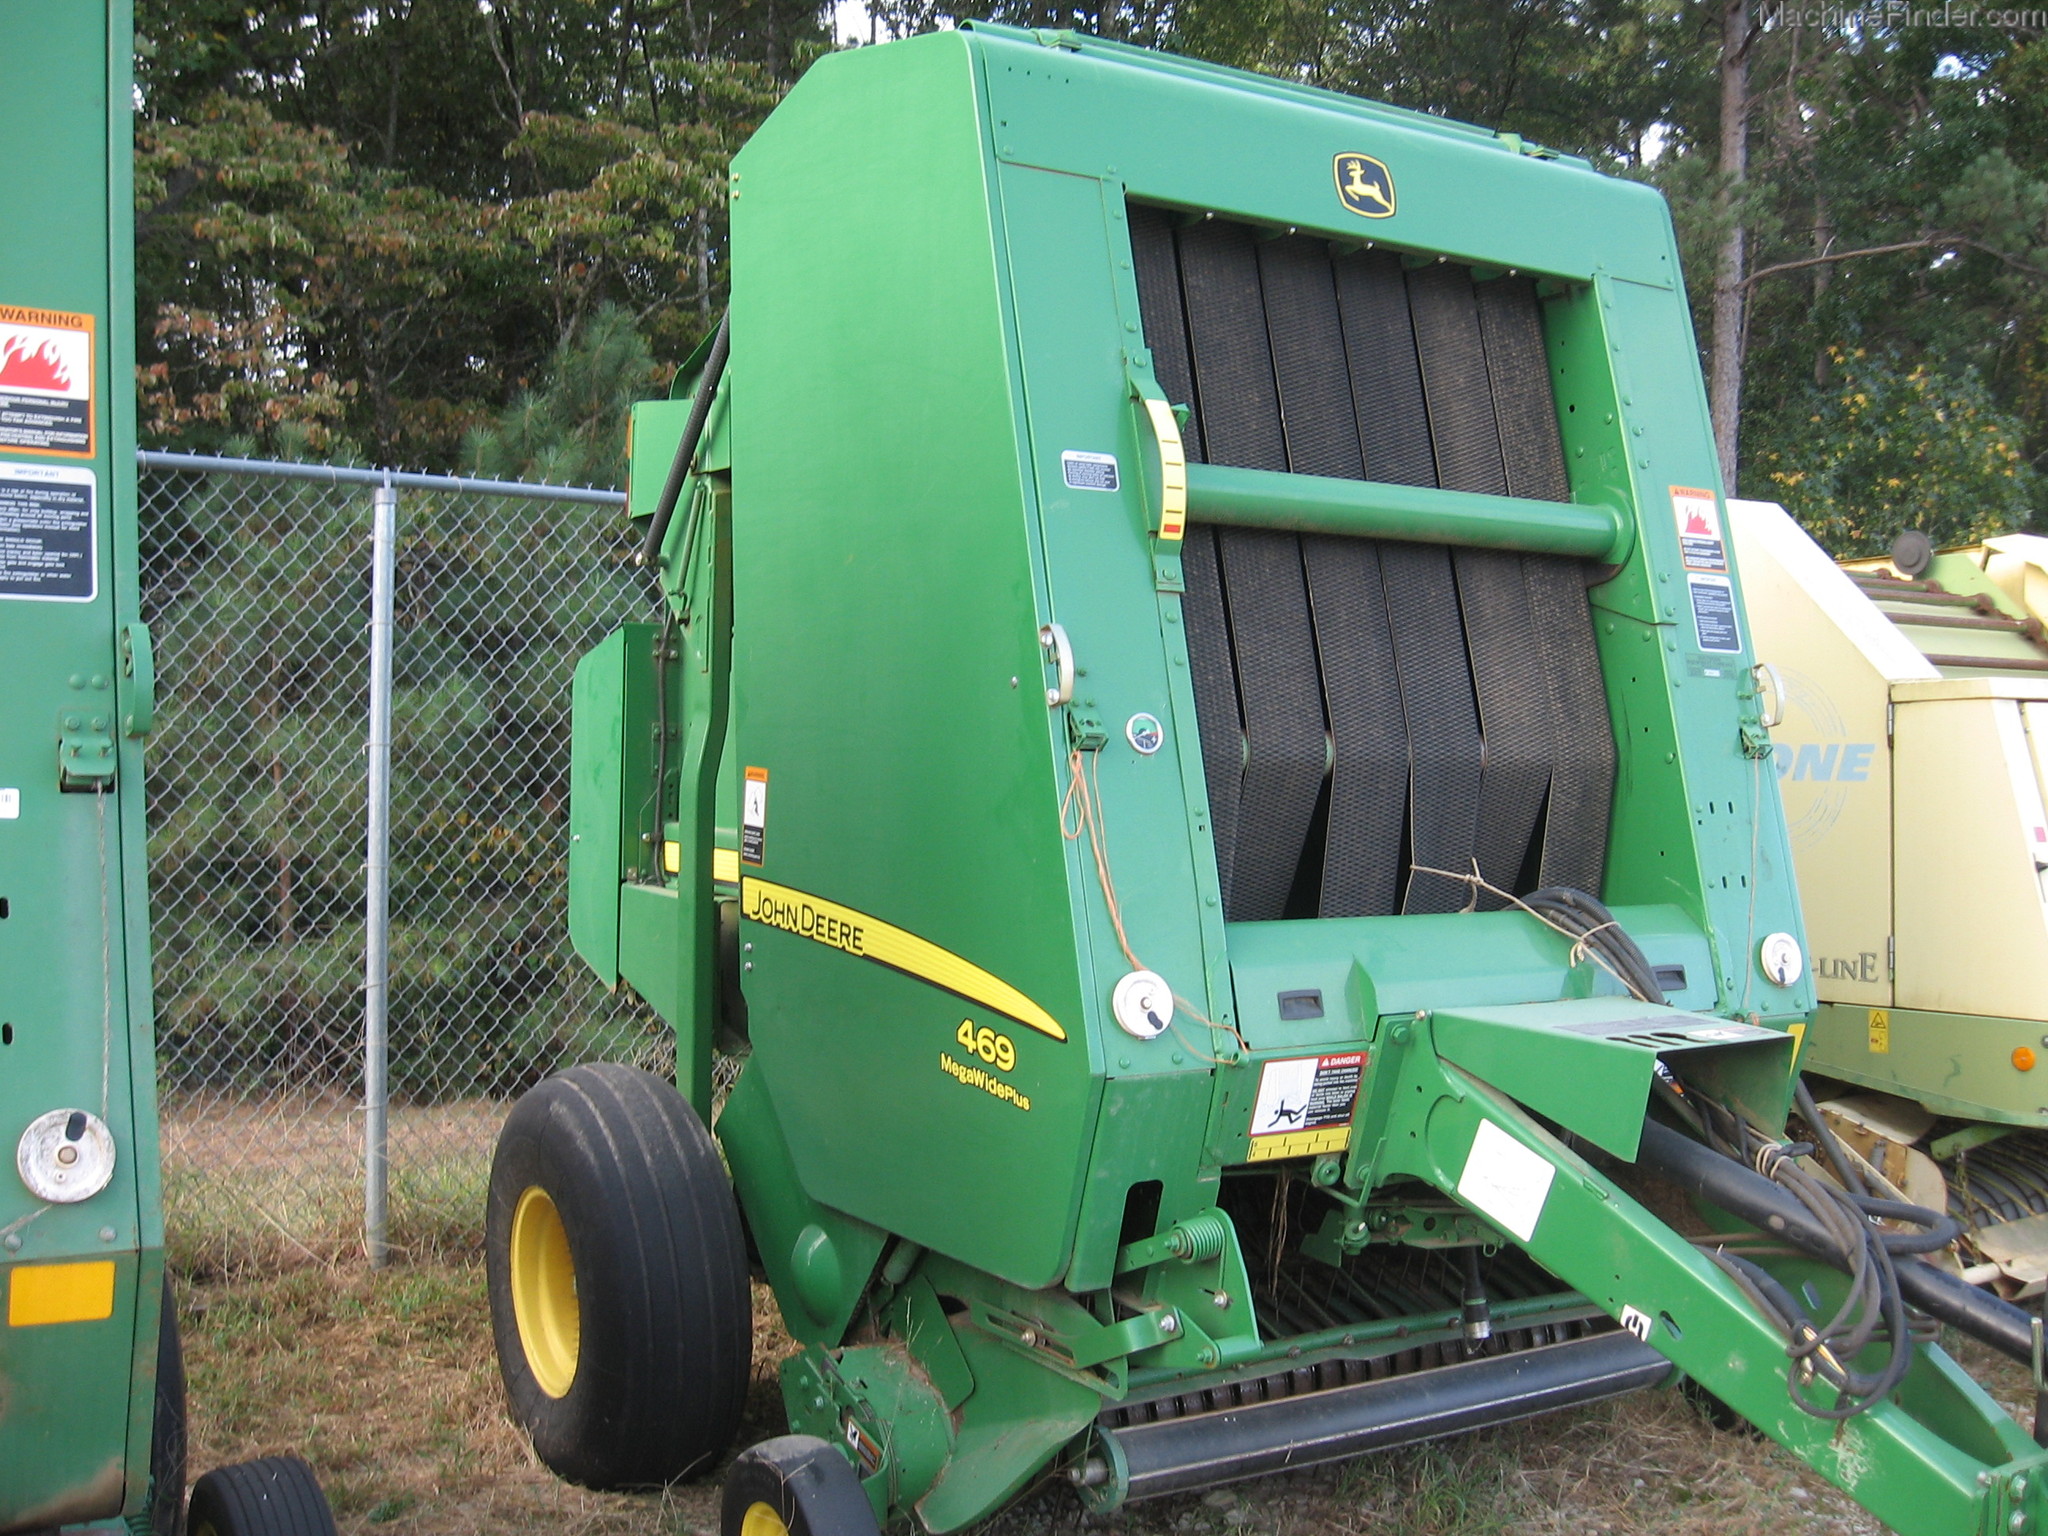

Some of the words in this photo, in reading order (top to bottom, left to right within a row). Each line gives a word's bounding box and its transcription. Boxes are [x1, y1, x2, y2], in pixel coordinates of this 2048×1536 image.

[0, 308, 83, 328] WARNING
[752, 889, 798, 929] JOHN
[801, 903, 864, 951] DEERE
[956, 1017, 1016, 1073] 469
[1330, 1055, 1361, 1066] DANGER
[940, 1050, 1031, 1112] MegaWidePlus
